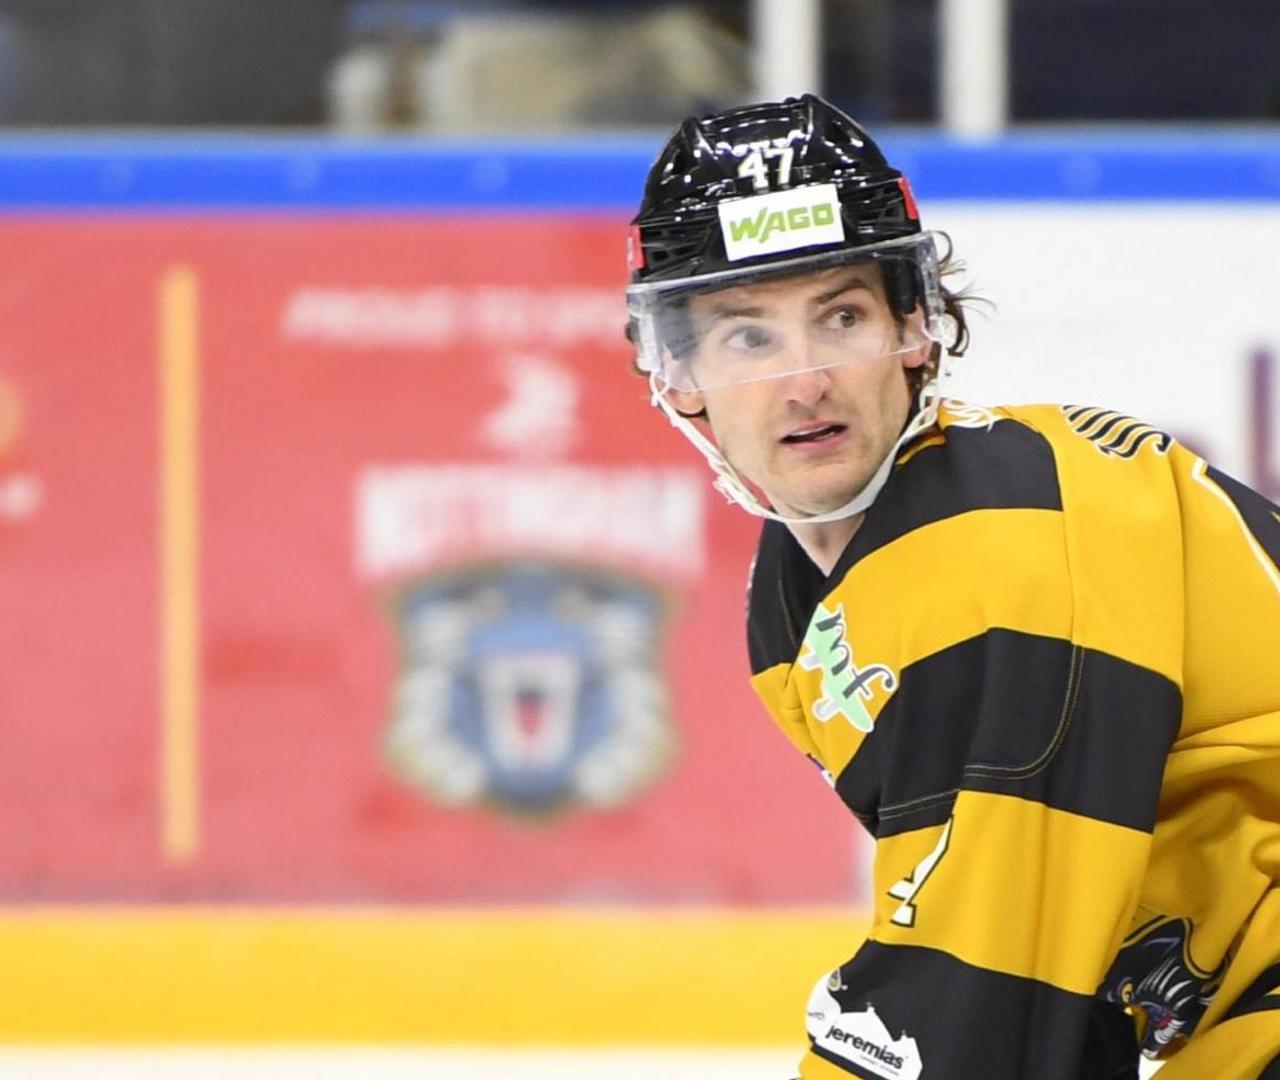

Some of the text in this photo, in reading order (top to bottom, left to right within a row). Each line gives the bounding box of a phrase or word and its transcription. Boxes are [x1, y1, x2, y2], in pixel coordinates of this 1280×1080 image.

[738, 147, 794, 190] 47
[729, 206, 834, 243] WAGO
[825, 1025, 905, 1070] jeremias
